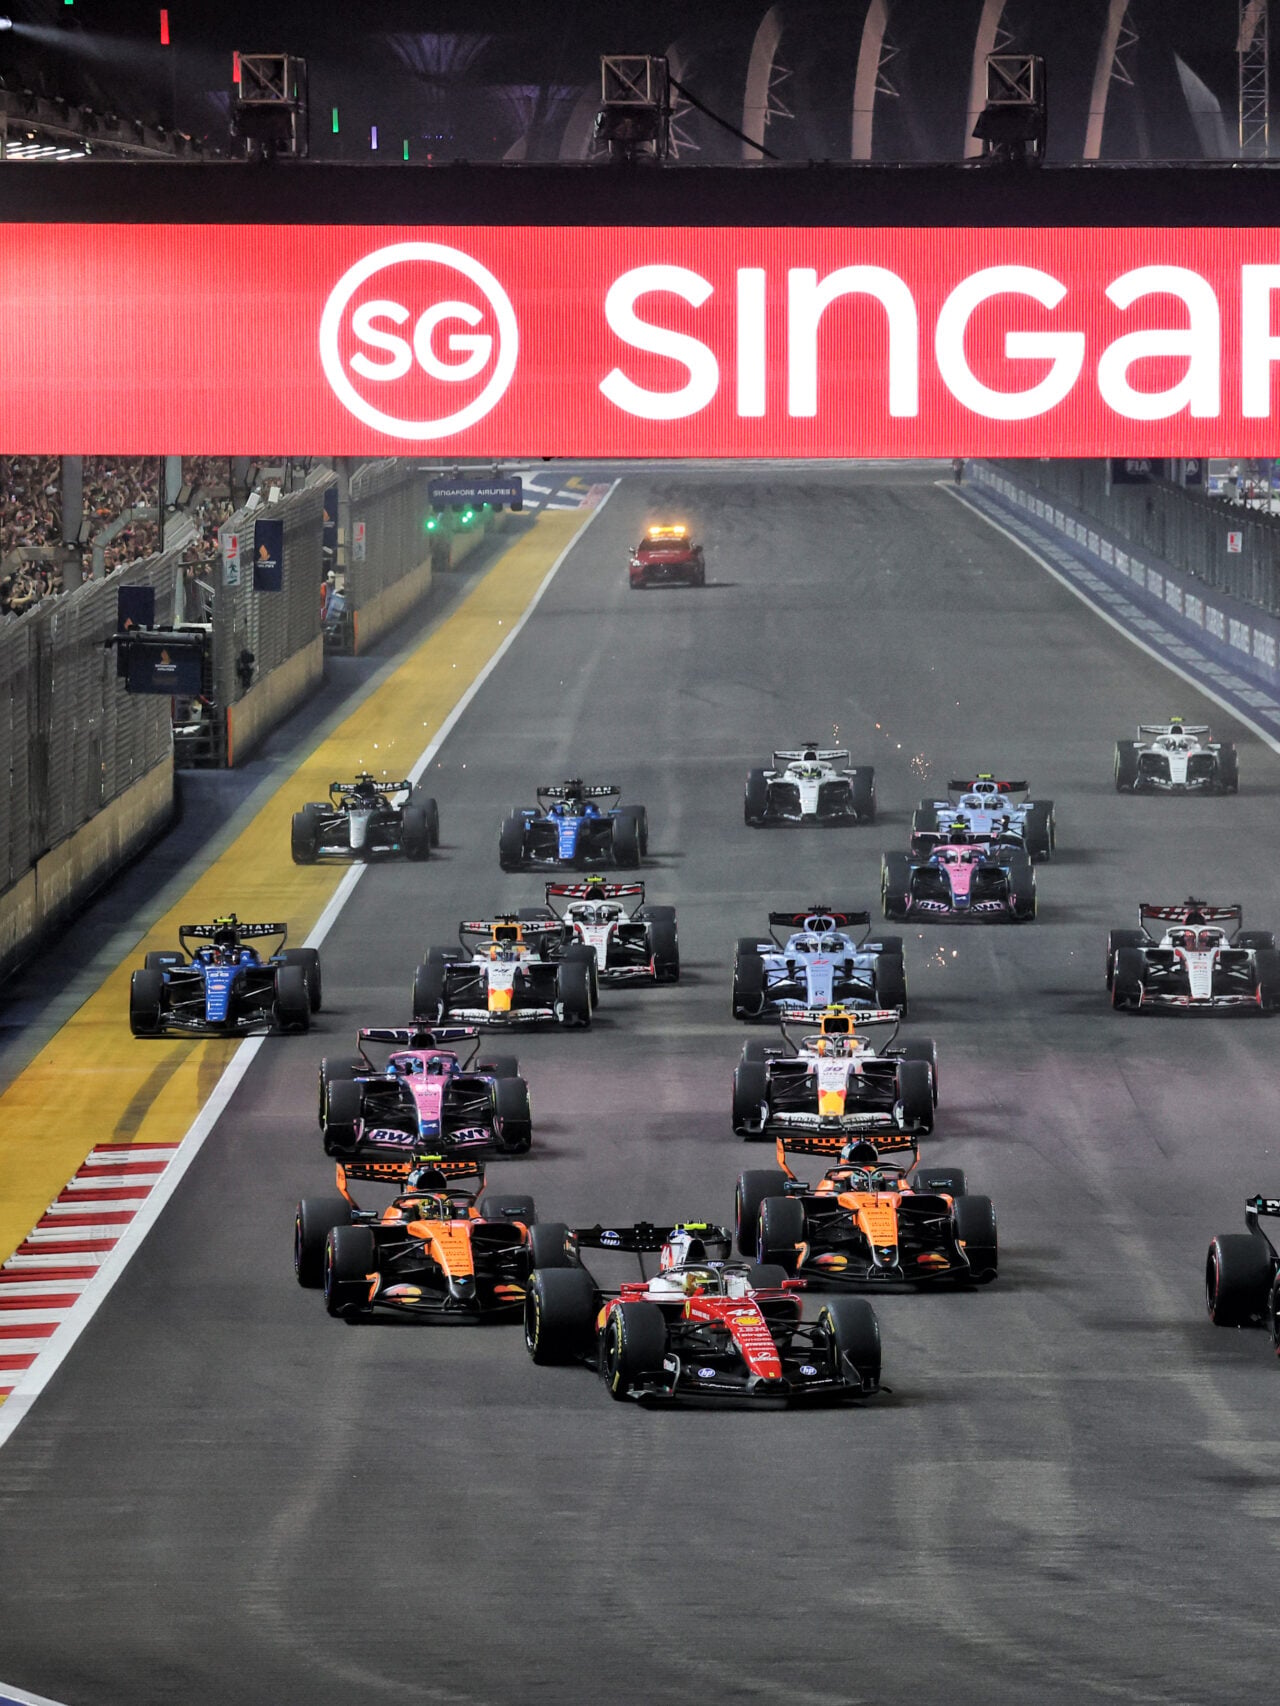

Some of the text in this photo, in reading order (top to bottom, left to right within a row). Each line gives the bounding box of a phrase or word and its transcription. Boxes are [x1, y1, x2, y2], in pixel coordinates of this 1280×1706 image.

[349, 299, 493, 382] SG
[702, 1367, 715, 1377] hp
[803, 1365, 816, 1376] hp
